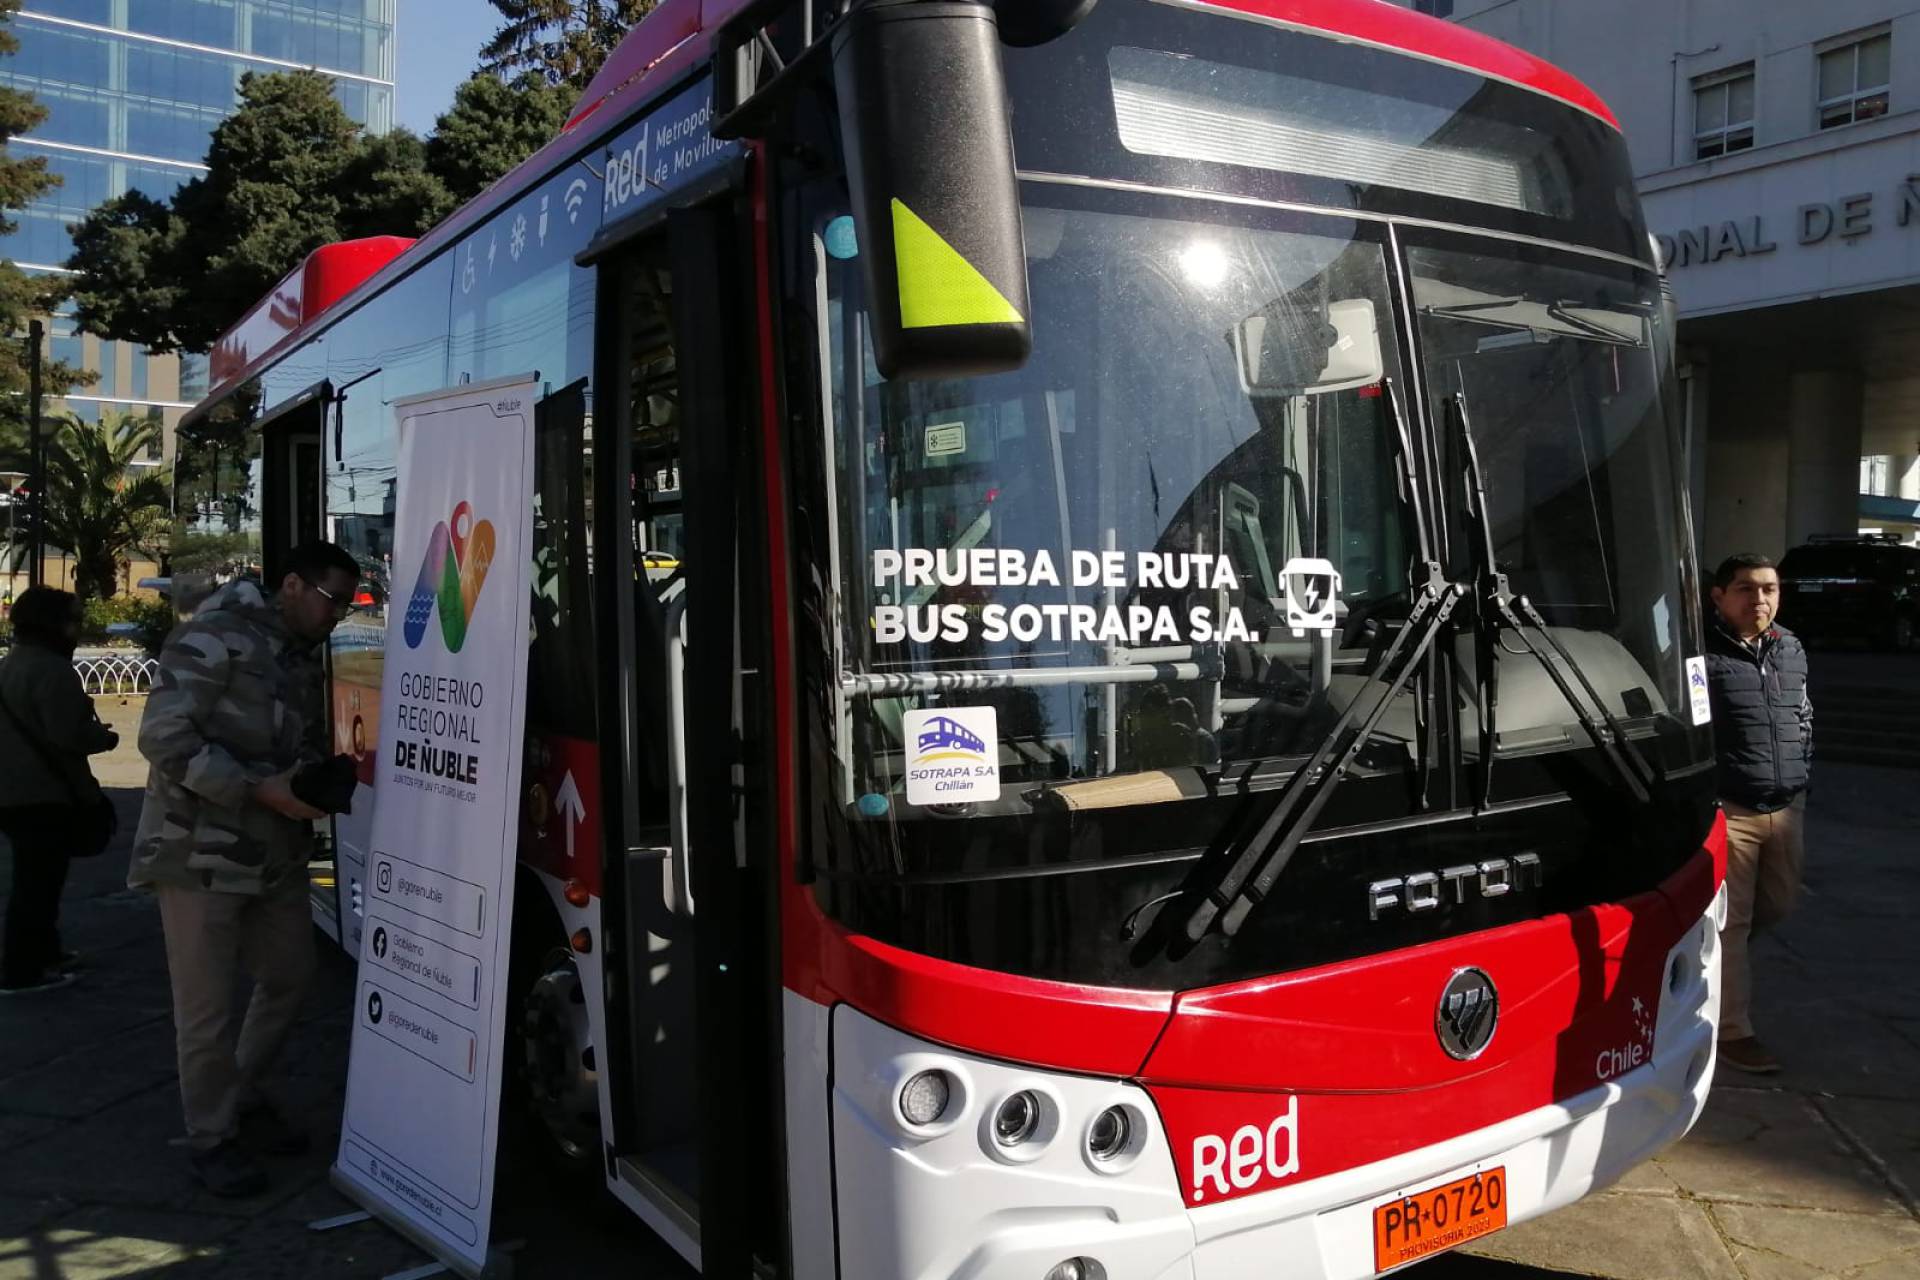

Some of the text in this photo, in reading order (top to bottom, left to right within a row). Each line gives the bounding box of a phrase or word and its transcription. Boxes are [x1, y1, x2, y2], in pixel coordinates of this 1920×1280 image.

[656, 96, 714, 152] Metropol
[604, 122, 648, 213] Red
[654, 160, 668, 185] de
[1798, 192, 1873, 246] DE
[873, 548, 1240, 590] PRUEBA DE RUTA
[875, 603, 968, 644] BUS
[981, 604, 1181, 643] SOTRAPA
[1190, 606, 1259, 643] S.A.
[400, 672, 483, 708] GOBIERNO
[397, 704, 480, 743] REGIONAL
[395, 738, 478, 785] DE ÑUBLE
[910, 767, 971, 780] SOTRAPA
[422, 965, 432, 979] de
[1596, 1041, 1643, 1079] Chile
[1193, 1094, 1300, 1202] Red
[1400, 1229, 1464, 1260] PROVISORIA
